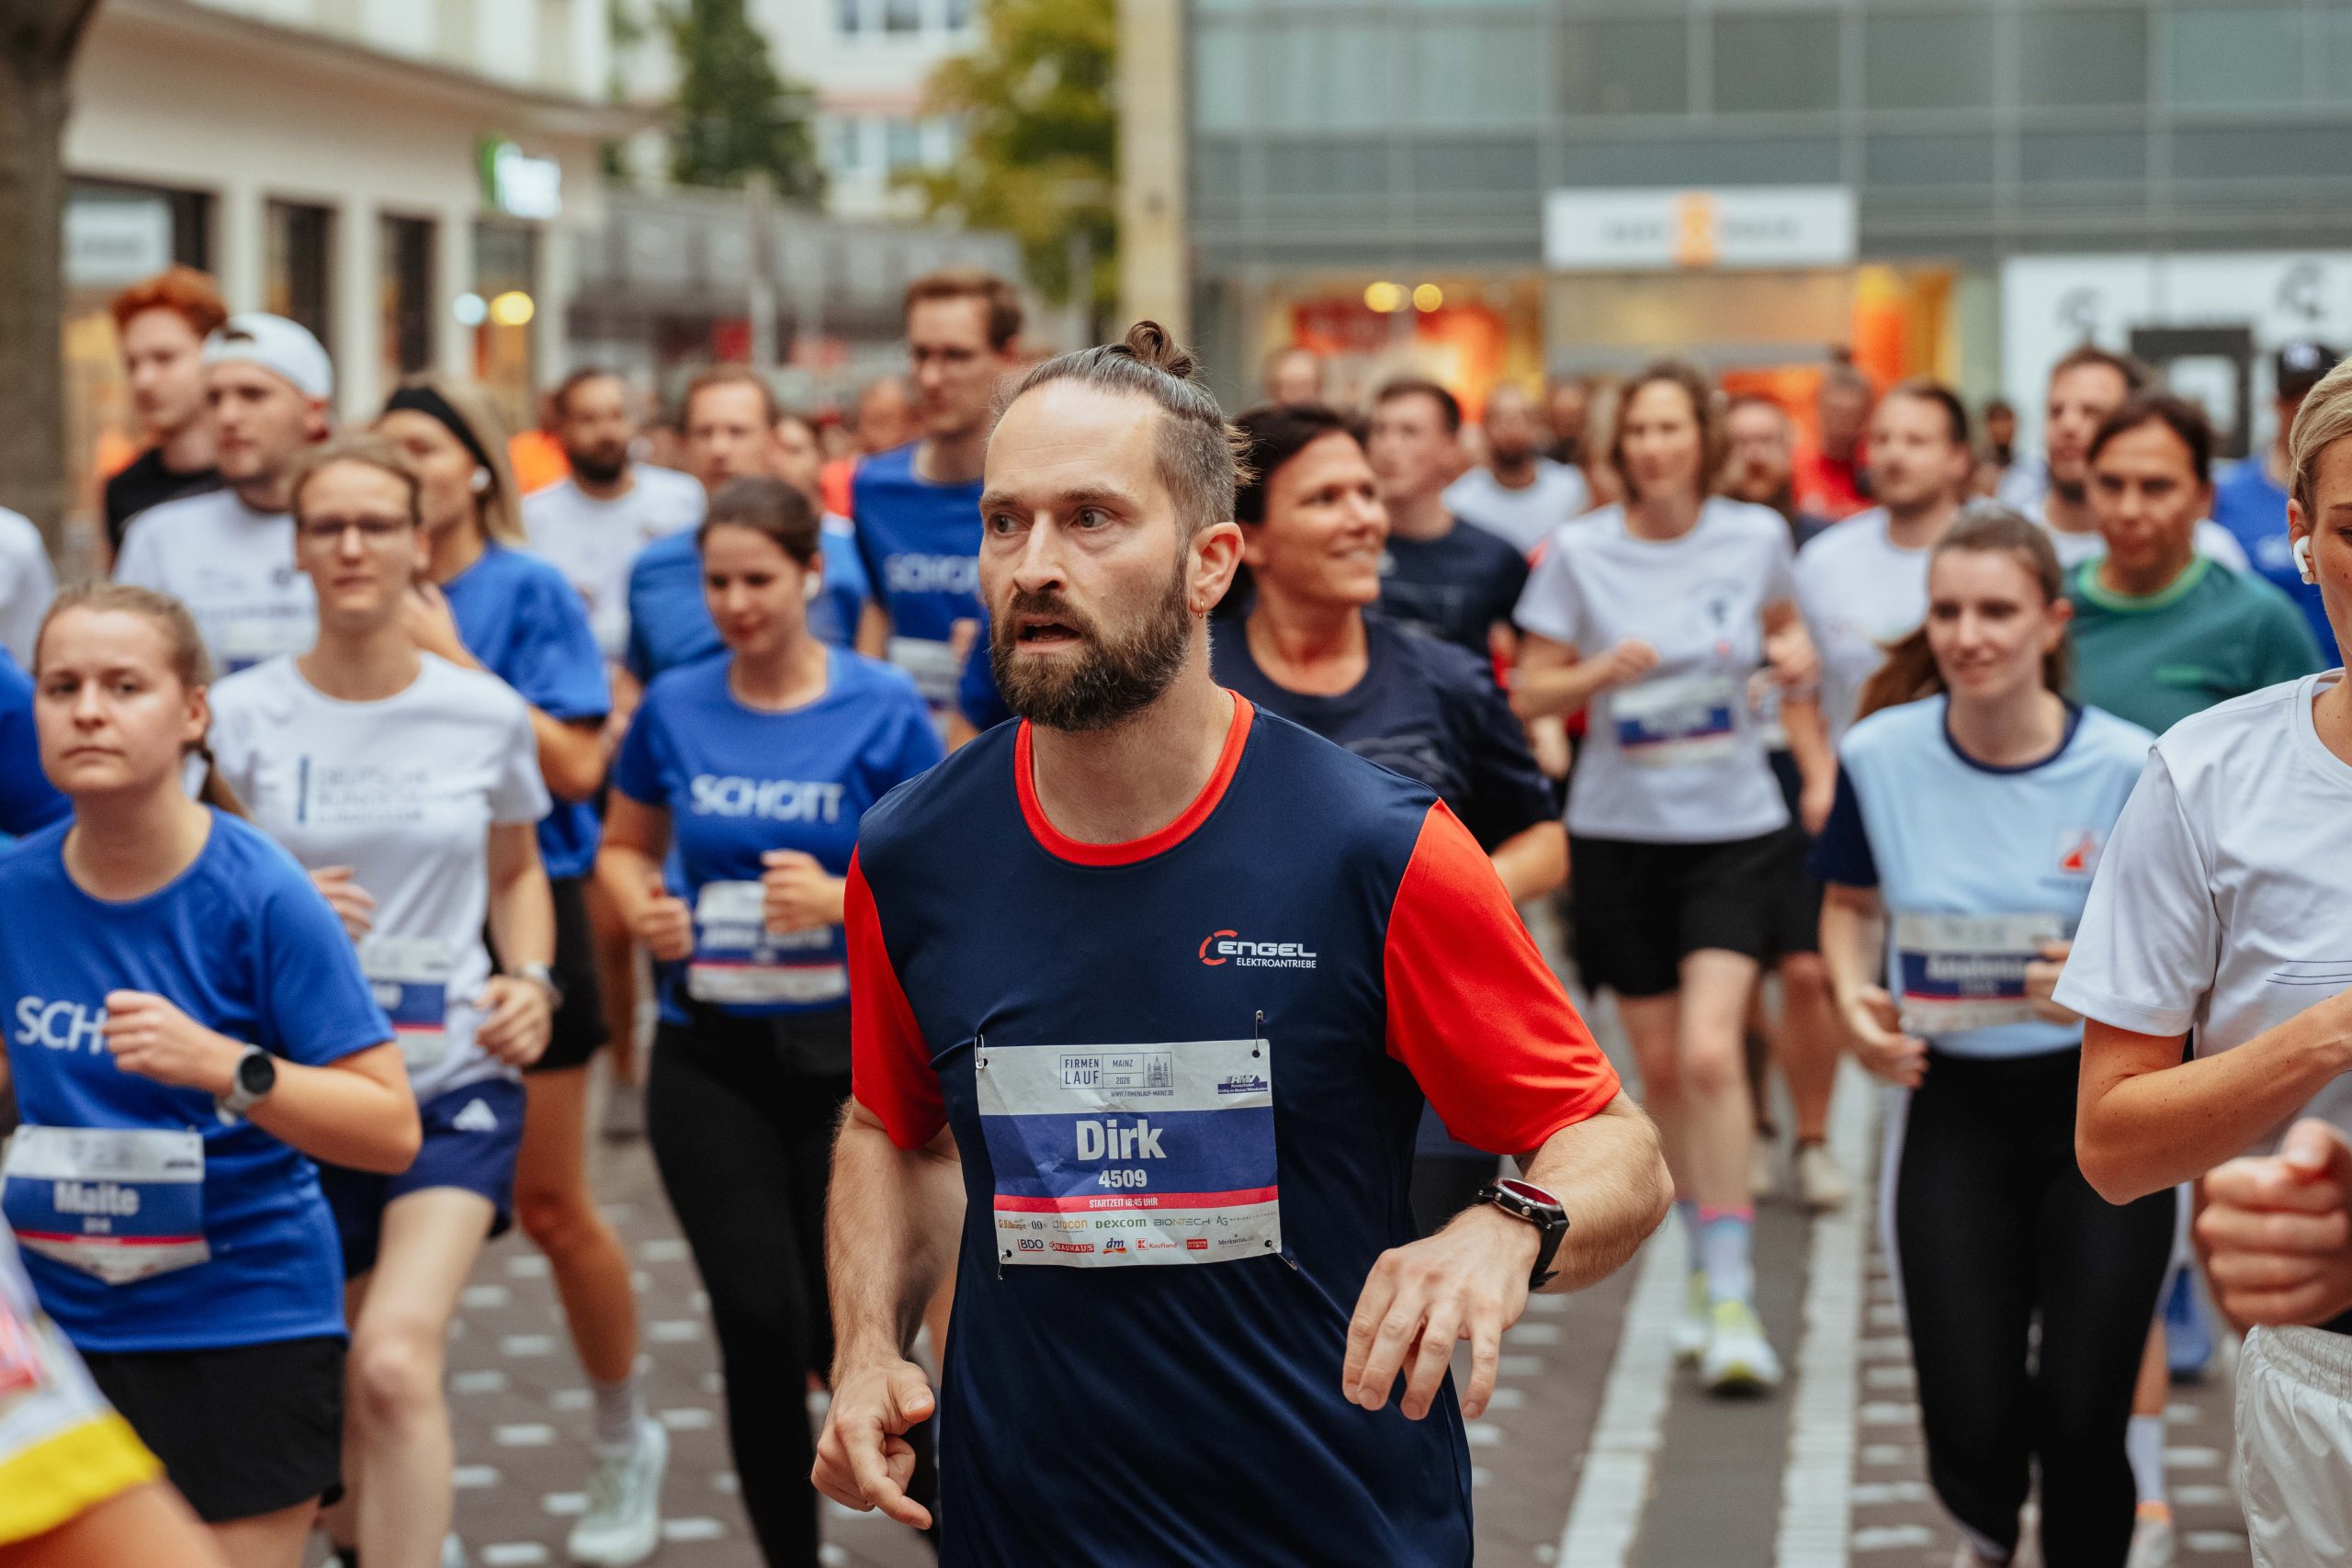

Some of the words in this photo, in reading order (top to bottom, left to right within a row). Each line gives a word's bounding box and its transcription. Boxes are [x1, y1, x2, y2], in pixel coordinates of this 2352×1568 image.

[691, 774, 844, 824] SCHOTT
[1217, 941, 1317, 957] ENGEL
[1236, 957, 1317, 969] ELEKTROANTRIEBE
[15, 995, 107, 1055] SCH
[1065, 1058, 1100, 1068] FIRMEN
[1113, 1059, 1134, 1067] MAINZ
[1065, 1070, 1100, 1085] LAUF
[1115, 1077, 1131, 1085] 2026
[1110, 1089, 1174, 1098] WWW.FIRMENLAUF-MAINZ.DE
[1076, 1119, 1168, 1161] Dirk
[1098, 1169, 1148, 1188] 4509
[1089, 1198, 1124, 1209] STARTZEIT
[1143, 1197, 1158, 1206] UHR
[1021, 1239, 1044, 1249] BDO
[1057, 1243, 1094, 1253] BAUHAUS
[1106, 1237, 1125, 1248] dm
